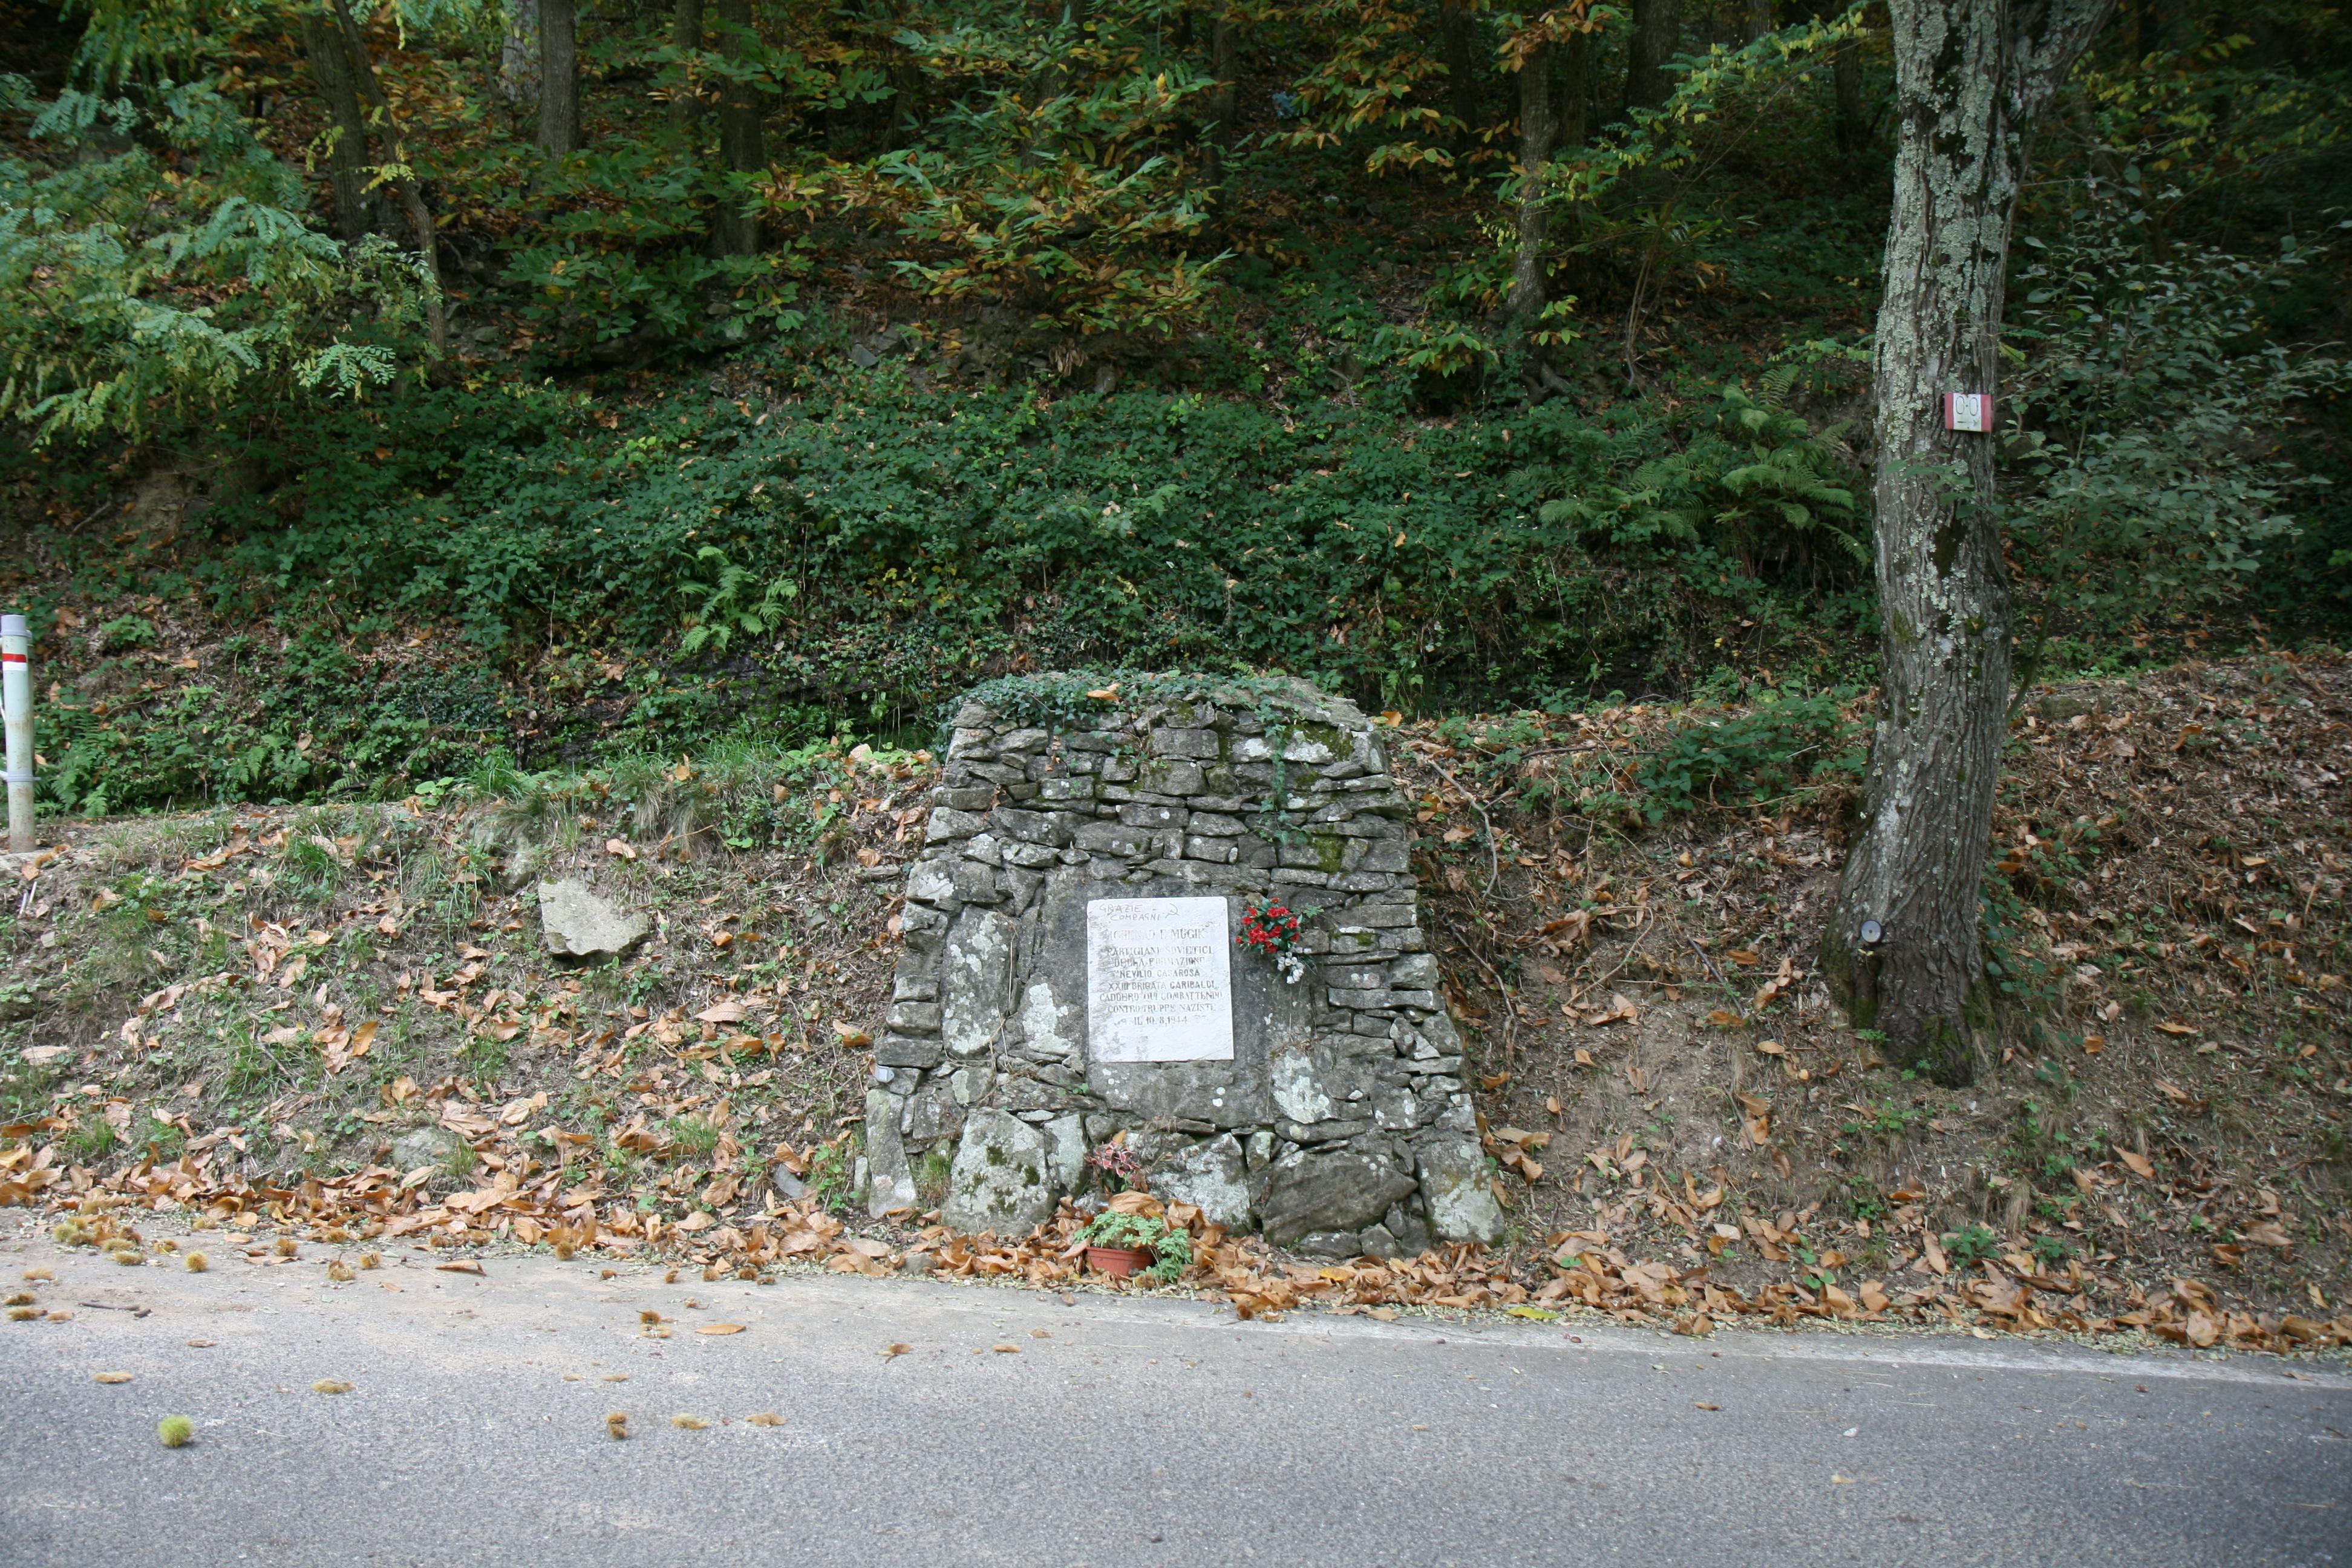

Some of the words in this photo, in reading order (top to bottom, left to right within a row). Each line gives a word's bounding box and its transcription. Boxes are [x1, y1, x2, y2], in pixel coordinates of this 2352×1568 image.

[1099, 903, 1143, 913] GRAZIE
[1107, 946, 1160, 956] PARTIGIANI
[1165, 946, 1212, 955] SOVIETICI
[1114, 958, 1147, 967] DELLA
[1149, 956, 1206, 966] FORMAZIONE
[1157, 969, 1201, 978] CASAROSA
[1132, 981, 1167, 991] BRIGATA
[1100, 993, 1139, 1002] CADDERO
[1108, 1005, 1141, 1014] CONTRO
[1143, 1004, 1176, 1014] TRUPPE
[1179, 1003, 1216, 1013] NAZISTE
[1134, 1016, 1143, 1025] IL
